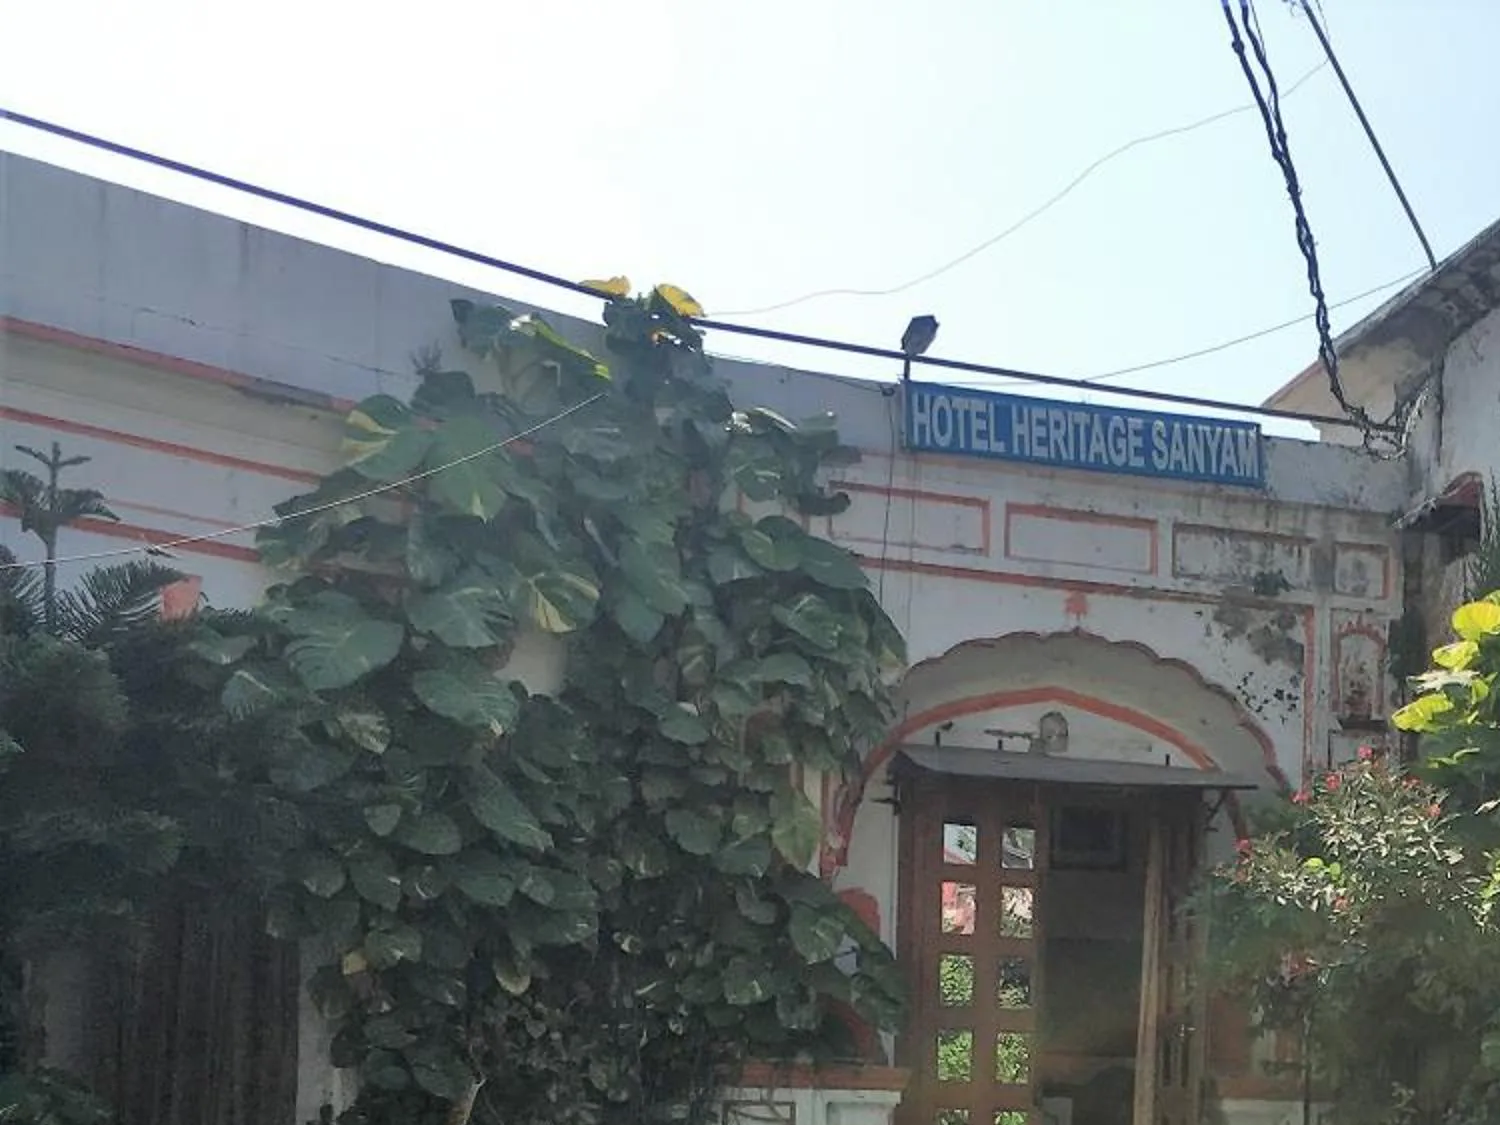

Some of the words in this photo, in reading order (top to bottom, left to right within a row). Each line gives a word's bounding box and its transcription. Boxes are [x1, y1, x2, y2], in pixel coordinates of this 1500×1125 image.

[912, 392, 1006, 454] HOTEL
[1011, 404, 1145, 469] HERITAGE
[1151, 419, 1259, 479] SANYAM
